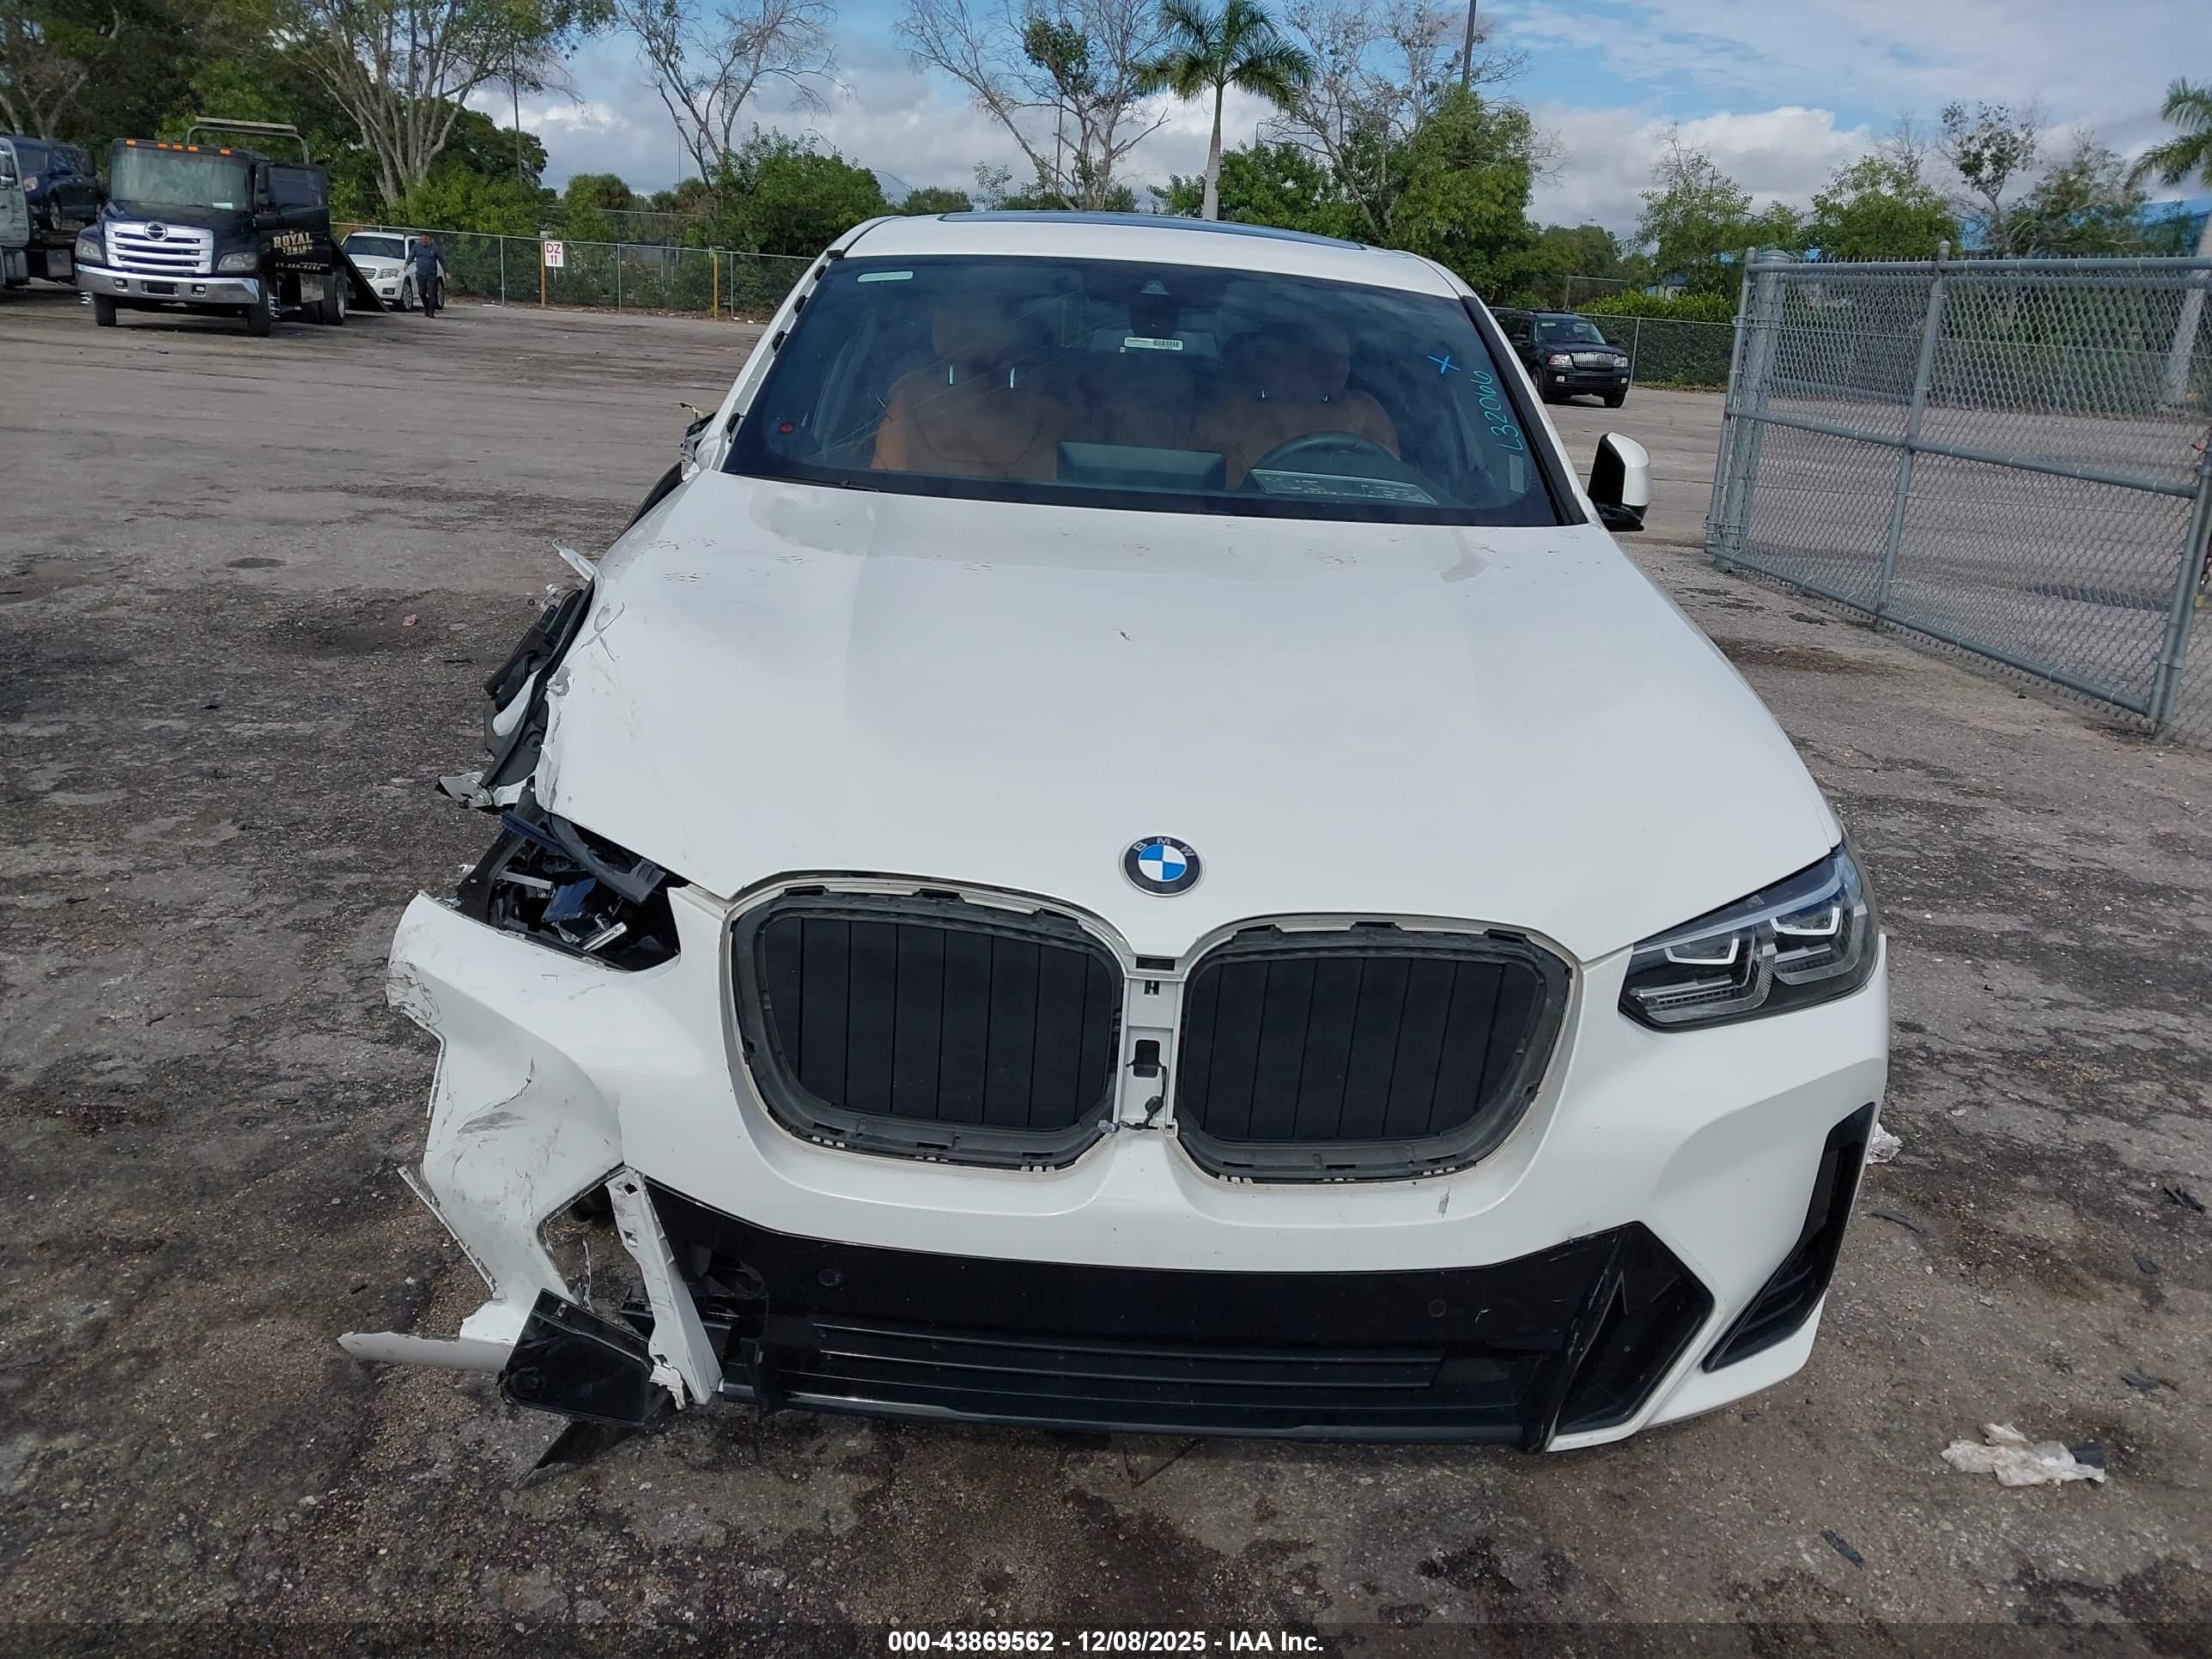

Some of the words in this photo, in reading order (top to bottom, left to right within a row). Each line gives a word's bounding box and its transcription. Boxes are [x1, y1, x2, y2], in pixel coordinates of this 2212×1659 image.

[273, 232, 313, 248] ROYAL
[546, 243, 562, 254] DZ
[550, 255, 557, 264] 11
[1470, 370, 1523, 451] L32066
[1132, 836, 1195, 857] BMW
